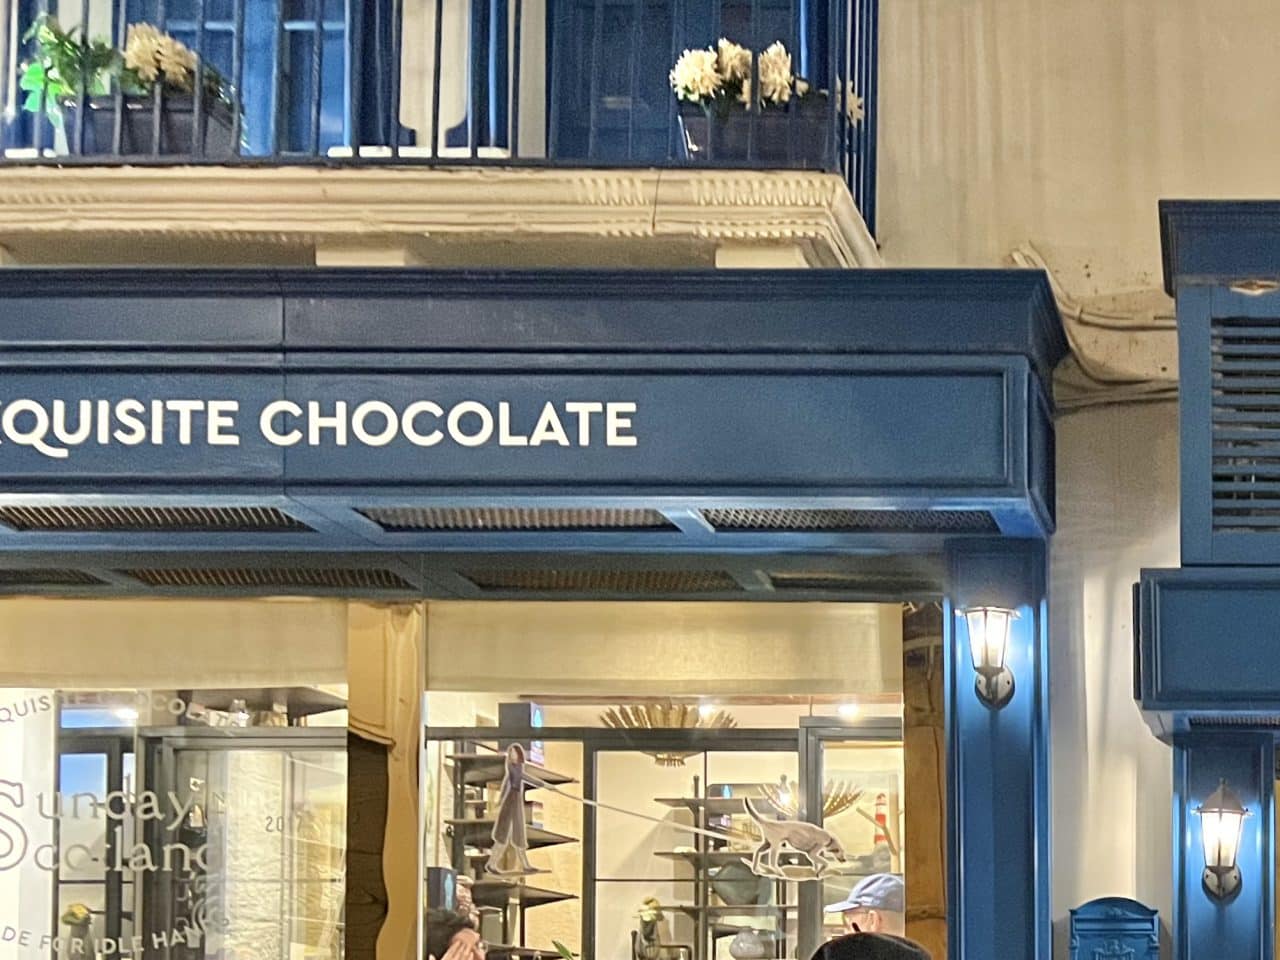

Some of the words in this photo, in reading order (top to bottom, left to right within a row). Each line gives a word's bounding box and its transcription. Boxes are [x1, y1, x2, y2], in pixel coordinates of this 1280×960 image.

[0, 399, 238, 457] QUISITE
[260, 401, 637, 447] CHOCOLATE
[39, 935, 85, 955] FOR
[94, 935, 144, 955] IDLE
